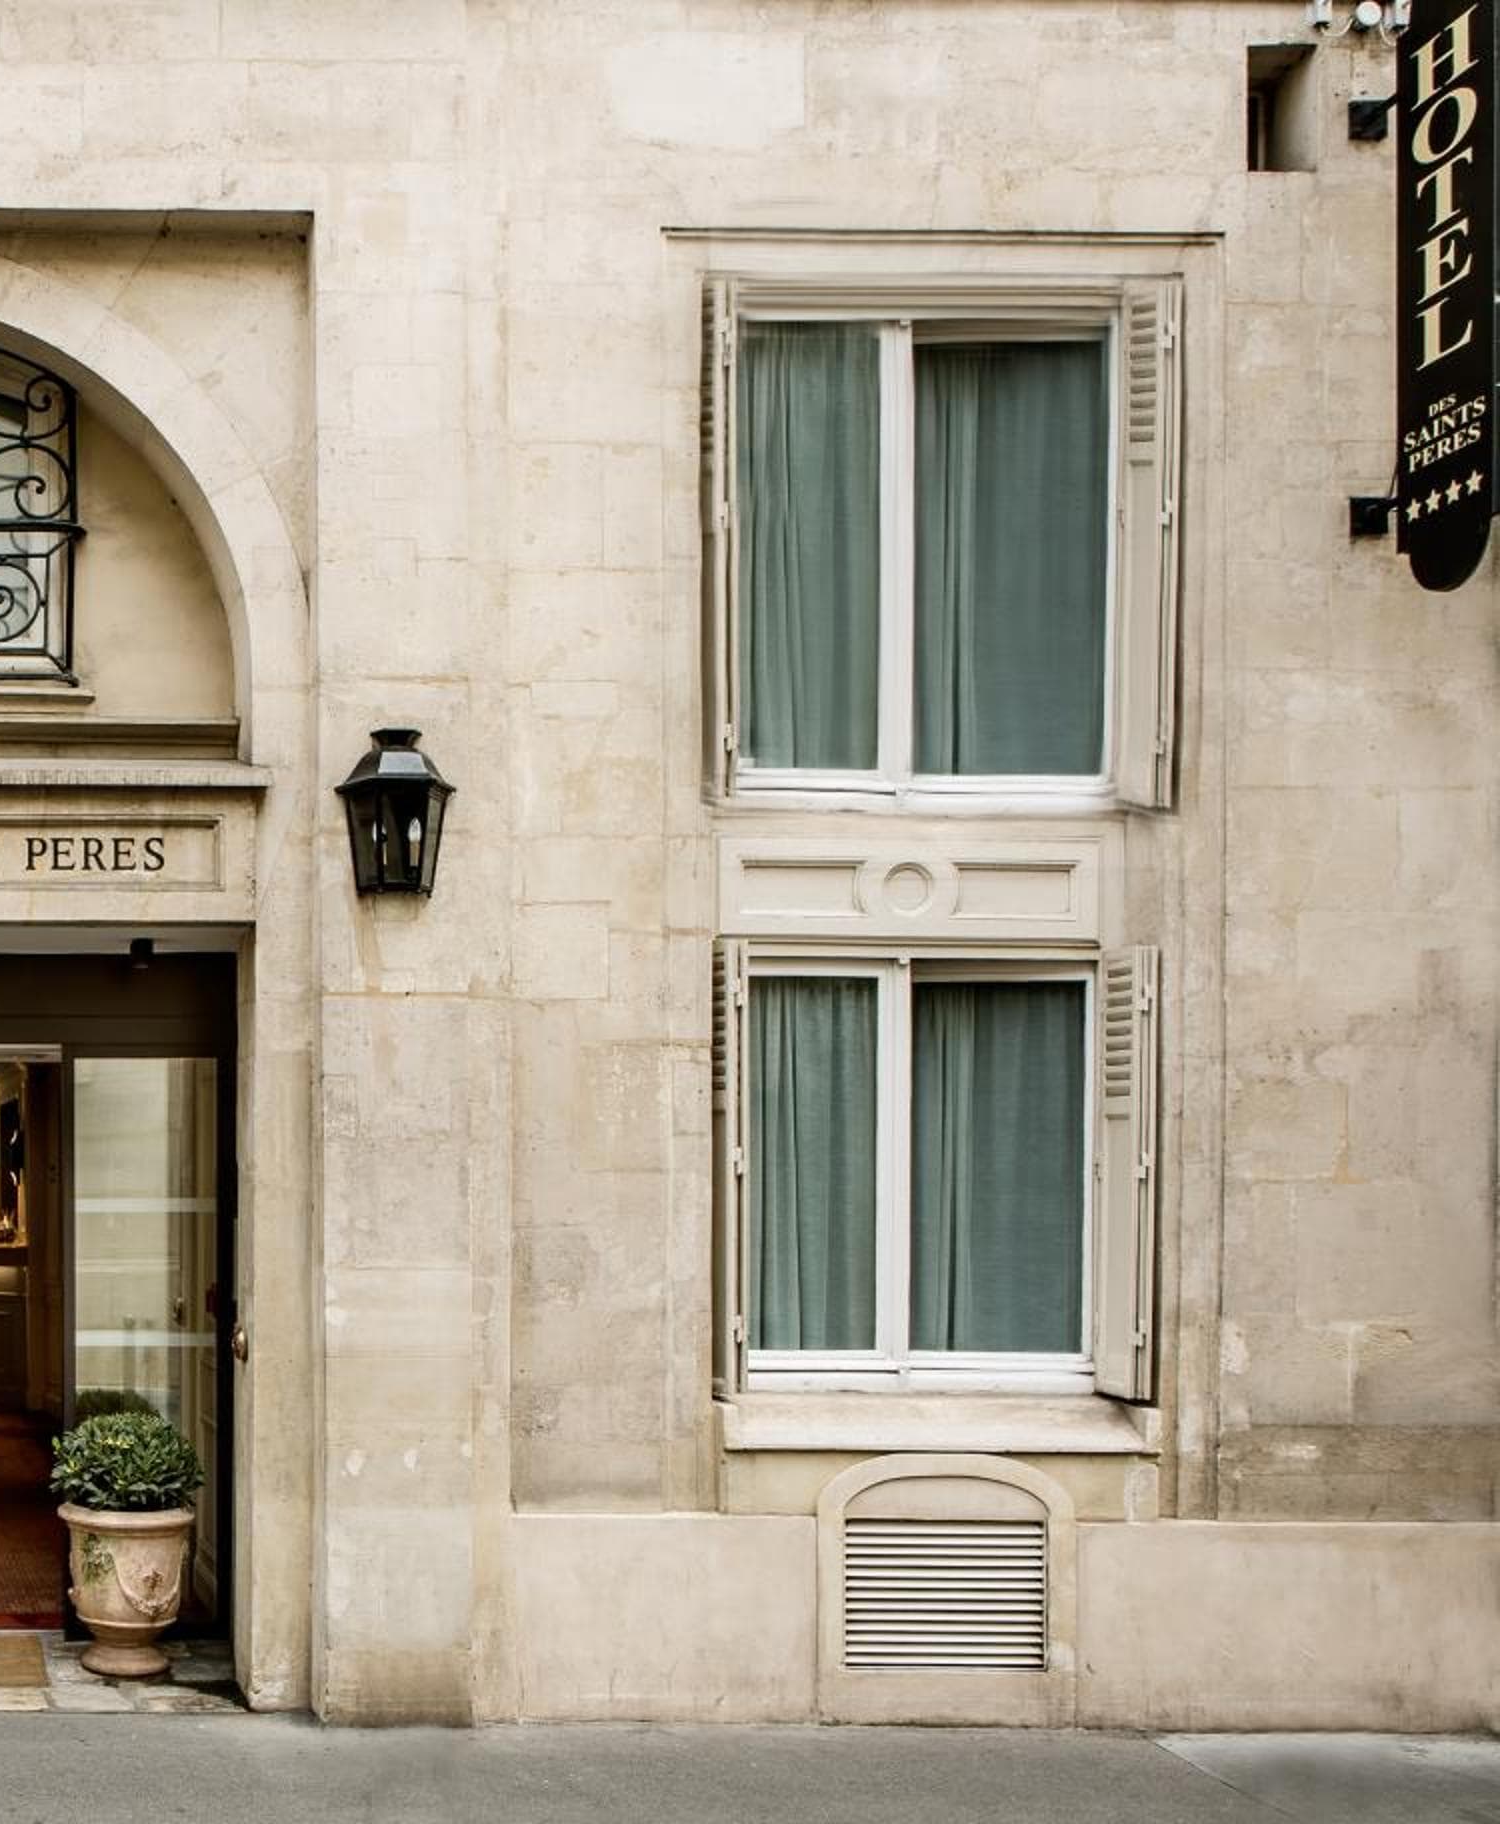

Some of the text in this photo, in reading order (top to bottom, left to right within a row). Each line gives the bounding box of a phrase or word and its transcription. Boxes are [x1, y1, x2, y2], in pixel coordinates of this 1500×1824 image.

[1410, 3, 1479, 372] HOTEL
[1403, 395, 1486, 453] SAINTS
[1428, 393, 1457, 417] DES
[1409, 421, 1481, 473] PERES
[25, 836, 166, 871] PERES
